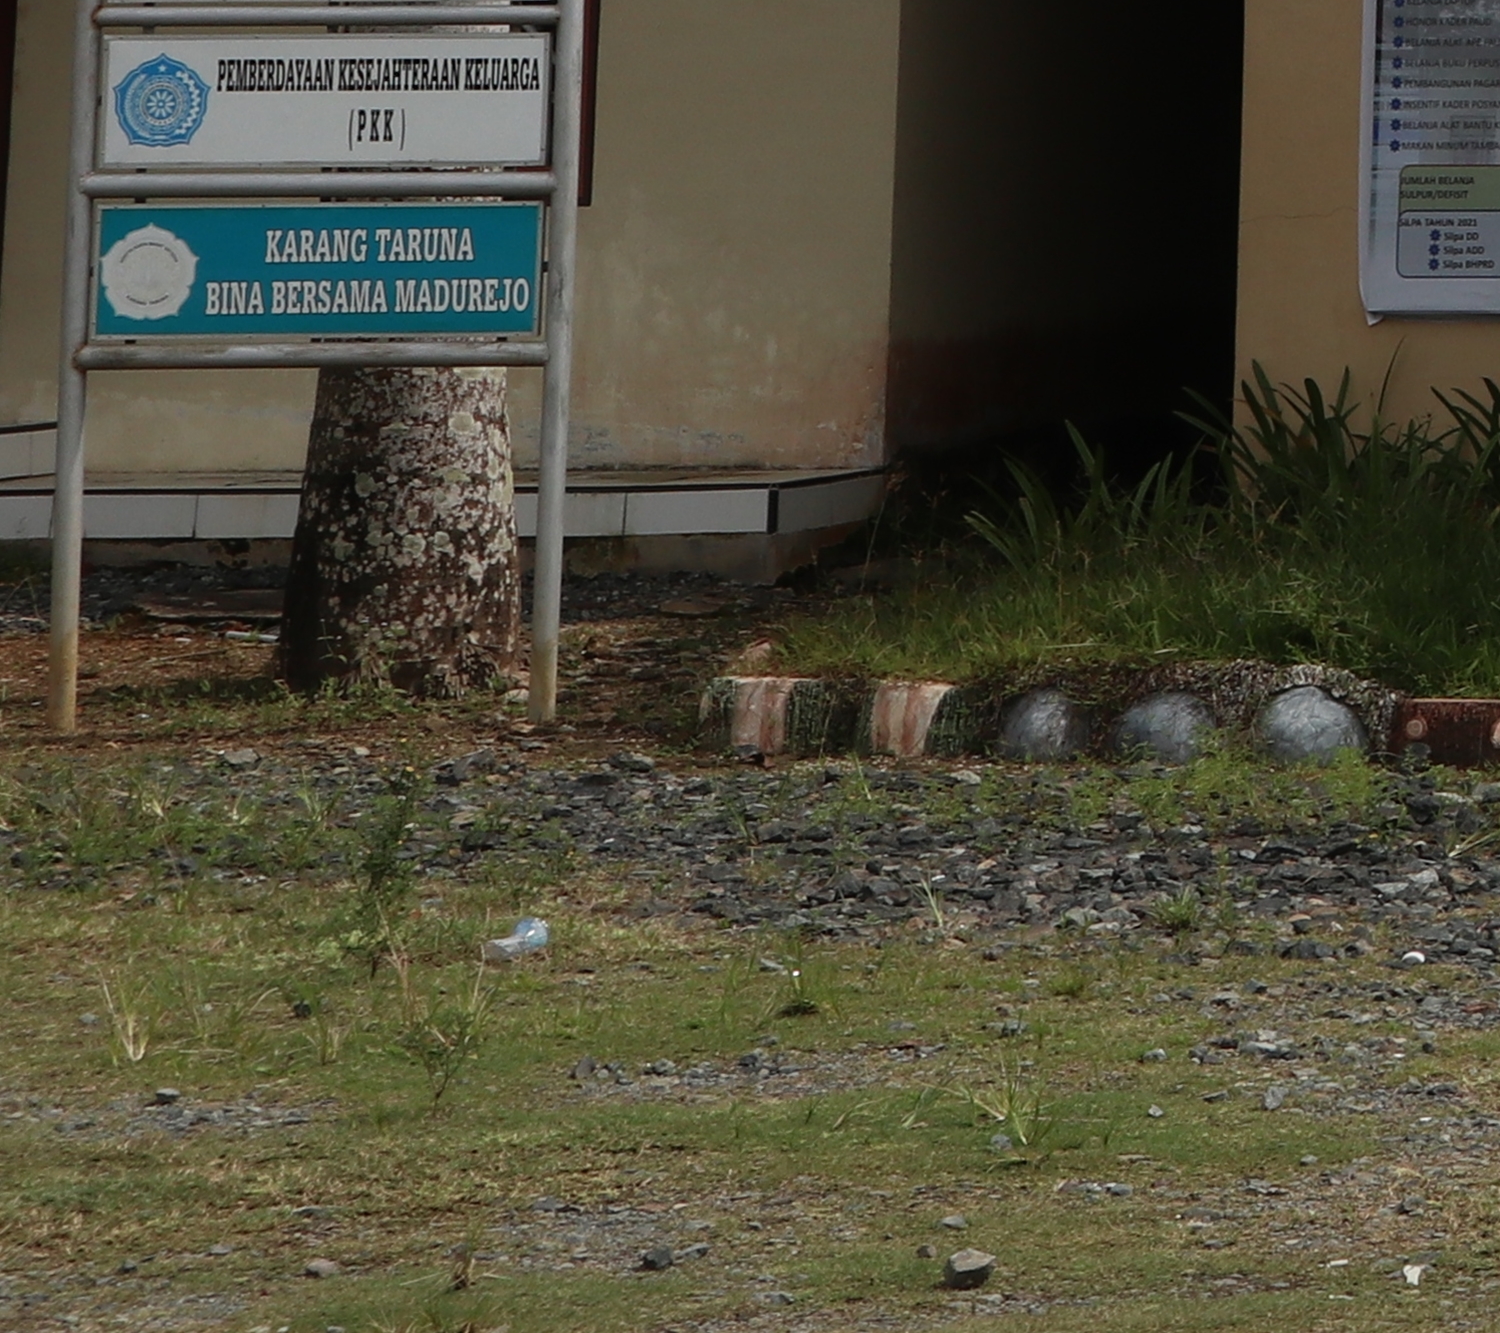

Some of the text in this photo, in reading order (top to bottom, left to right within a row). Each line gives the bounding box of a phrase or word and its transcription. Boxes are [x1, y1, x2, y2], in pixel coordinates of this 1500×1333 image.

[217, 57, 540, 92] PEMBERDAYAAN KESEJAHTERAAN KELUARGA
[1424, 218, 1454, 227] TAHUN
[1457, 218, 1477, 227] 2021
[264, 228, 474, 263] KARANG TARUNA
[205, 277, 530, 316] BINA BERSAMA MADUREJO
